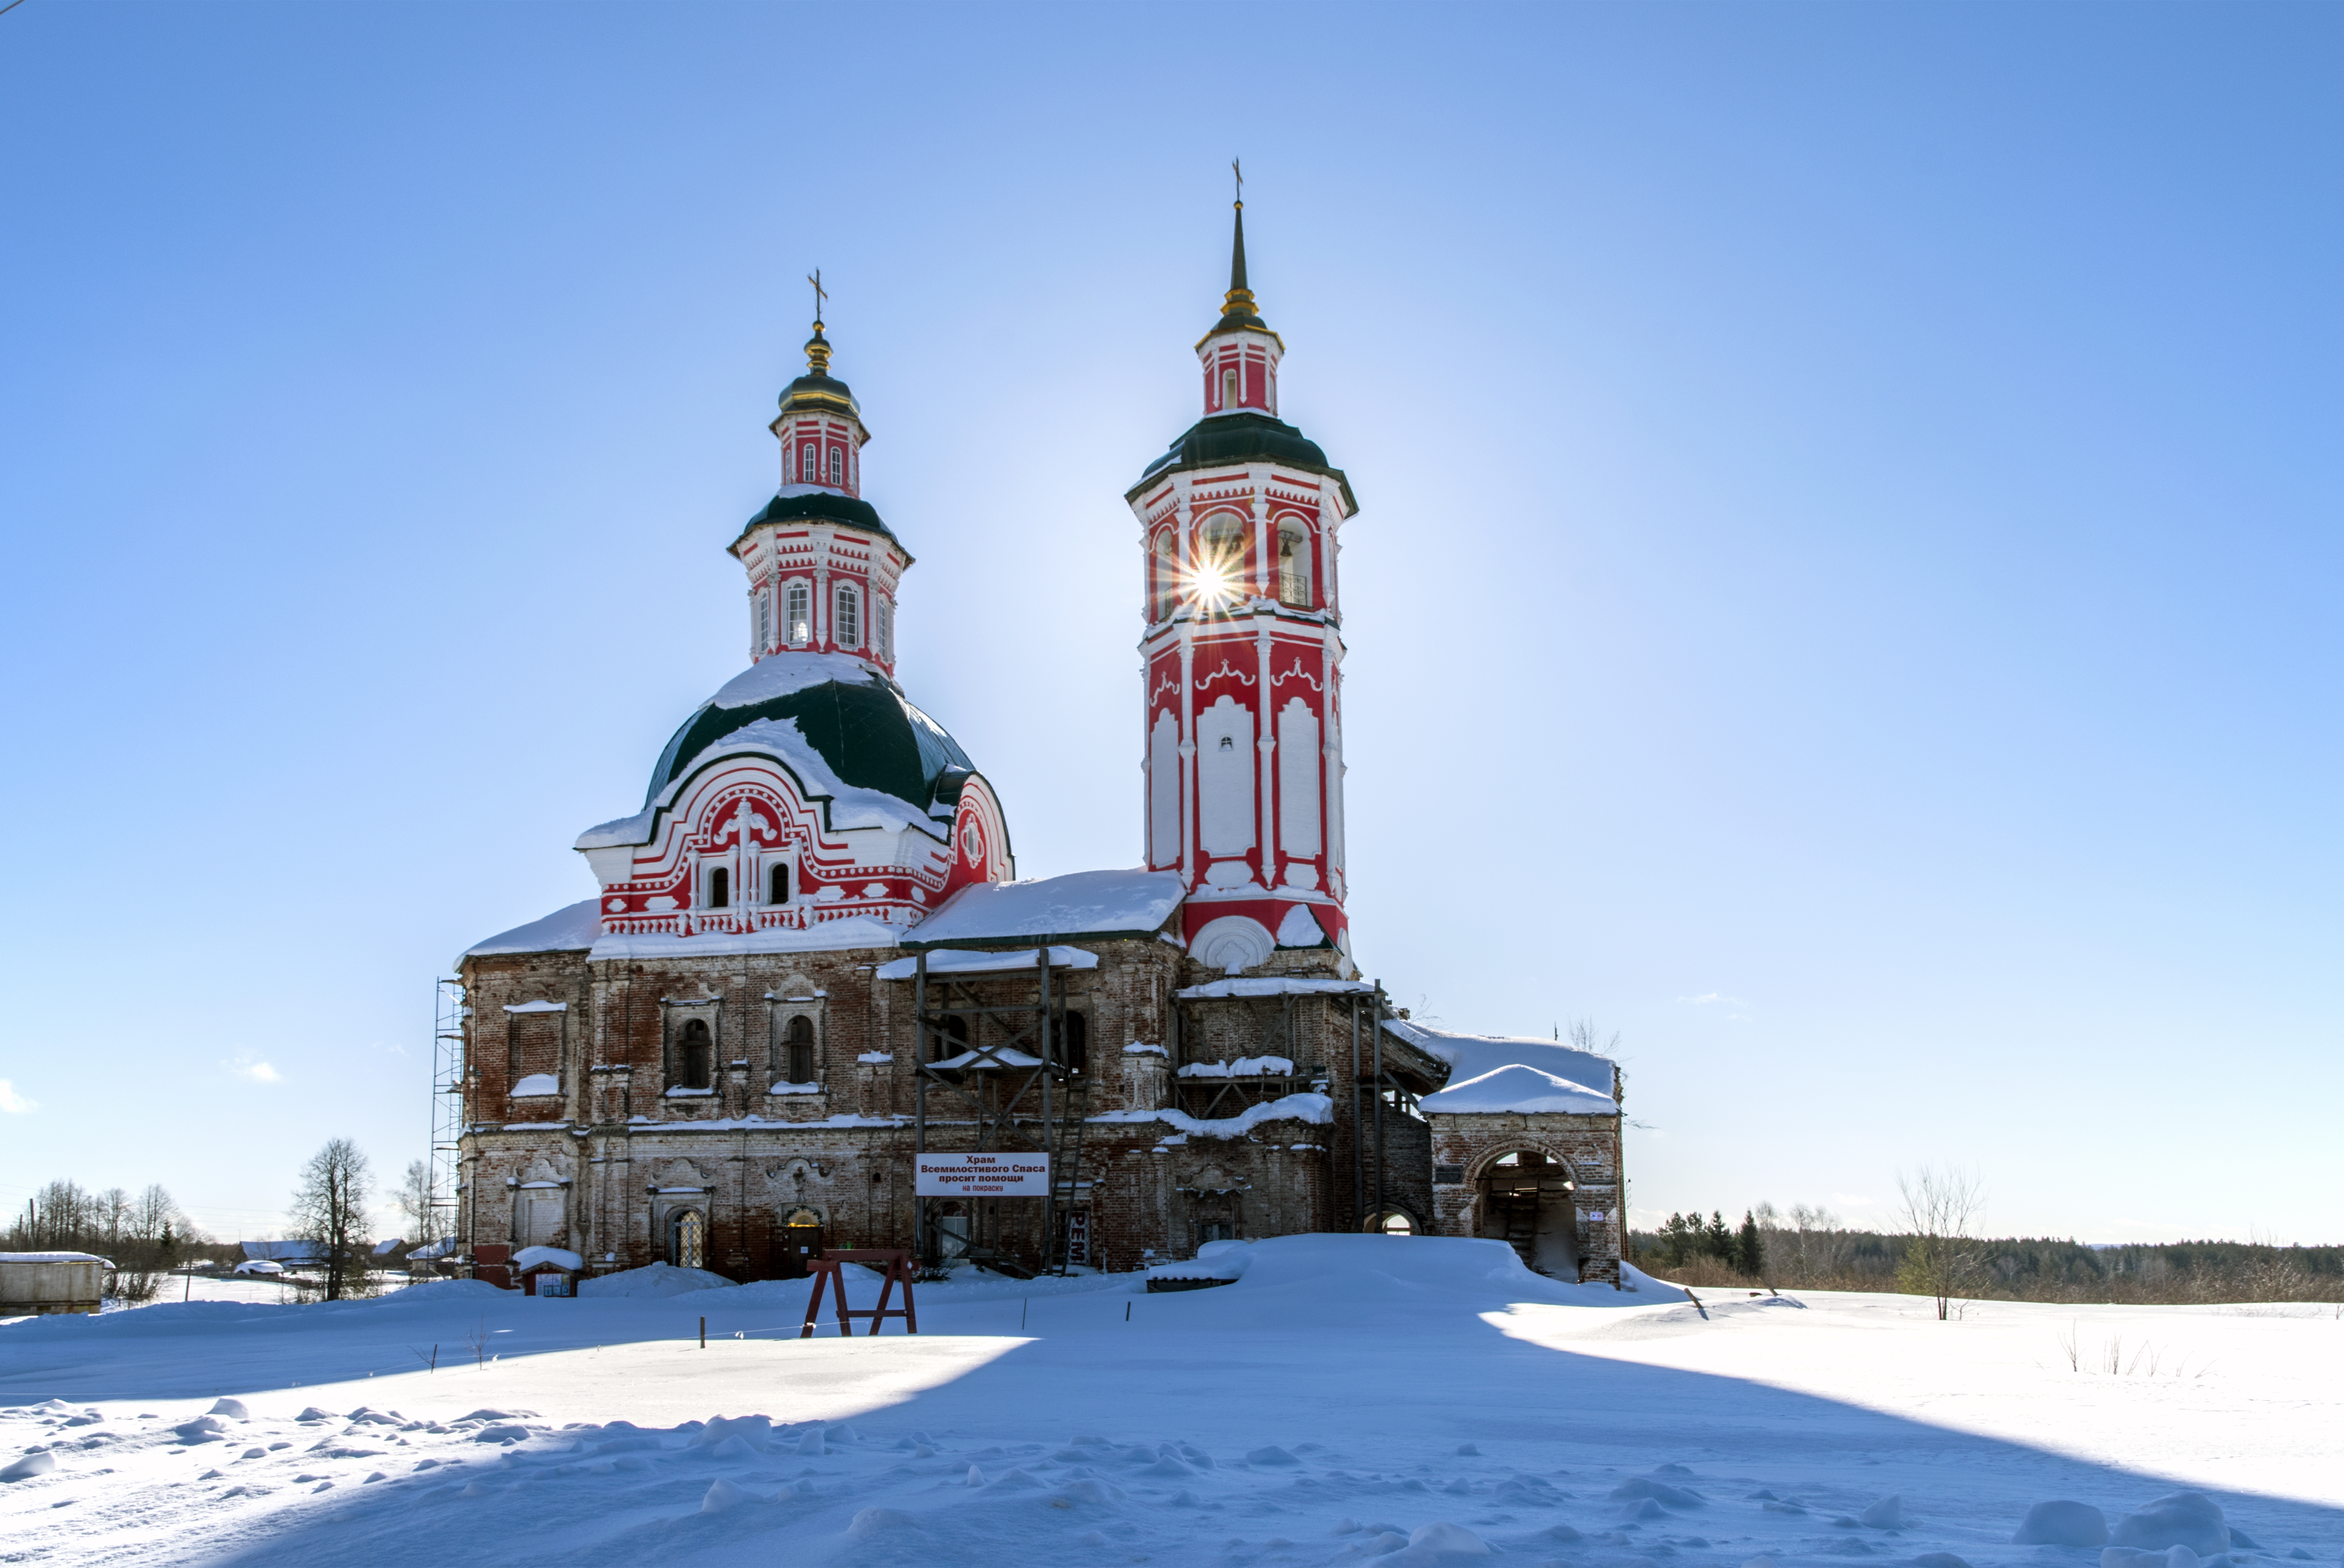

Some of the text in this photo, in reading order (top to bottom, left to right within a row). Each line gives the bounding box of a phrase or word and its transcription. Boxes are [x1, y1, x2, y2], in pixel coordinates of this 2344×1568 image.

[966, 1155, 995, 1165] Храм
[1012, 1164, 1045, 1172] Спаса
[1071, 1213, 1085, 1265] РЕМ
